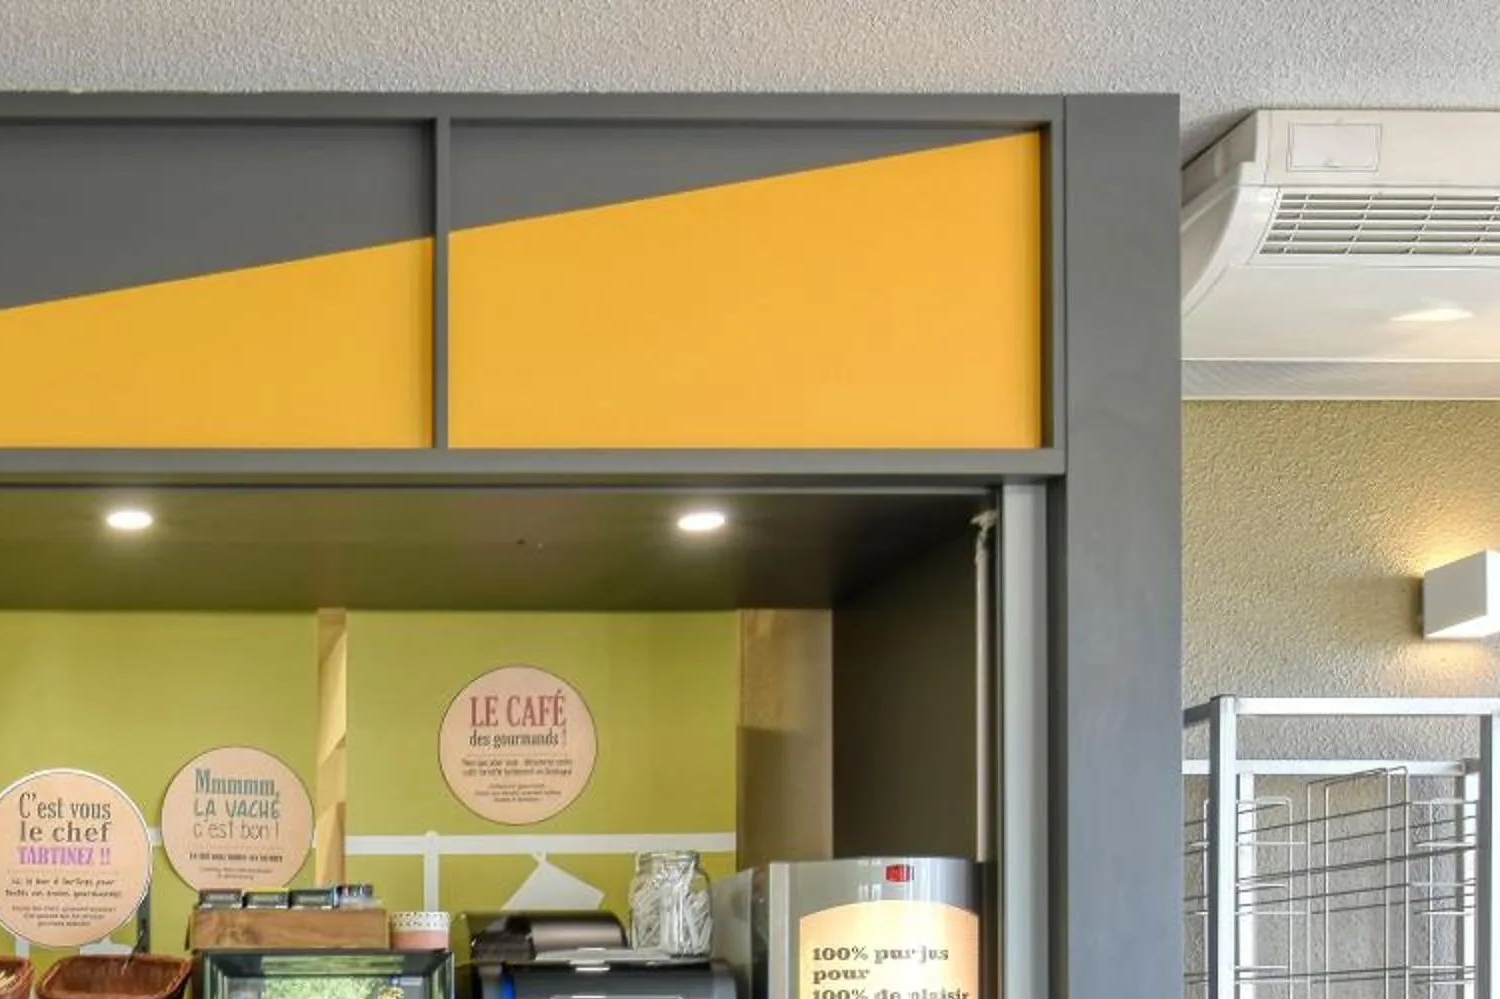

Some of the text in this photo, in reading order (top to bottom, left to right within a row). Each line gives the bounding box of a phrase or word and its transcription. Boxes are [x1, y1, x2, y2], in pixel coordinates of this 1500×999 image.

[470, 689, 567, 728] LE CAFÉ
[469, 729, 491, 746] des
[493, 728, 559, 748] gourmands
[19, 791, 111, 819] C'est vous
[193, 800, 280, 819] LA VACHE
[20, 821, 112, 842] le chef
[241, 821, 270, 840] bon
[16, 846, 94, 866] TARTINEZ
[812, 945, 949, 964] 100% pur jus
[812, 969, 870, 984] pour
